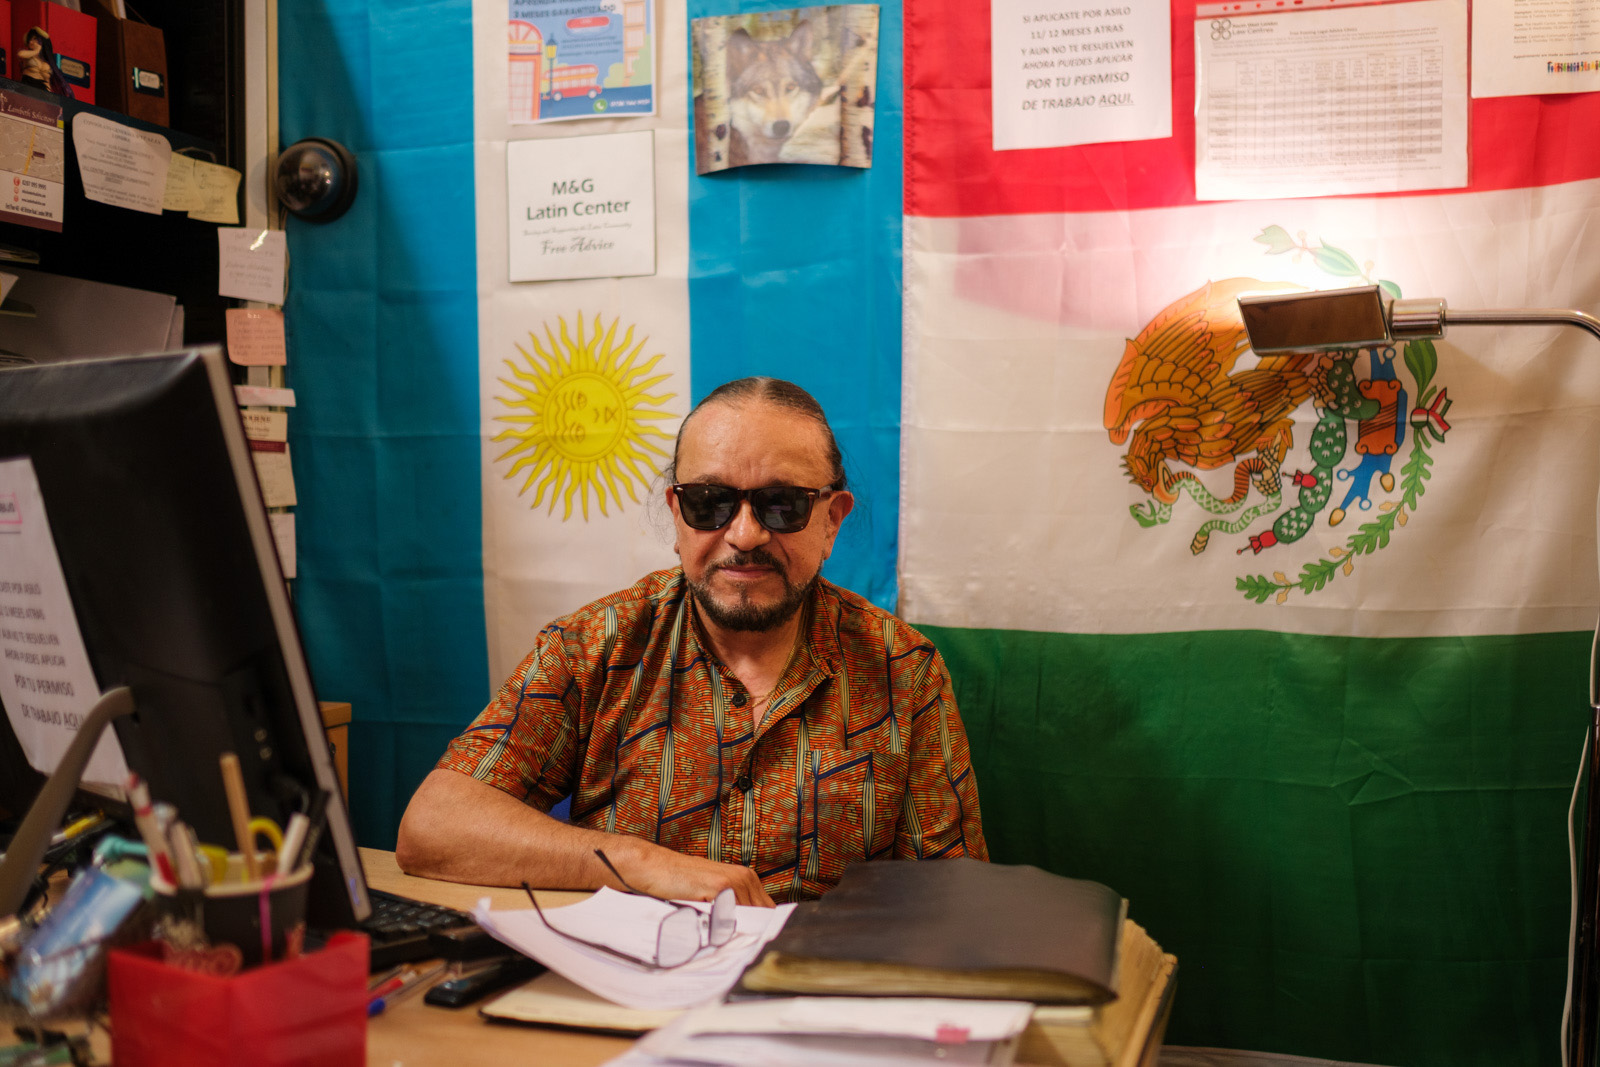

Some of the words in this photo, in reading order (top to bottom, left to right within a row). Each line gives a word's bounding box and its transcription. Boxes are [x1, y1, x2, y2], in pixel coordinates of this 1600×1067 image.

[1033, 12, 1080, 23] APLICASTE
[1082, 10, 1102, 19] POR
[1104, 6, 1132, 17] ASILO
[1062, 27, 1092, 37] MESES
[1094, 24, 1124, 34] ATRAS
[1029, 46, 1050, 56] AUN
[1052, 46, 1066, 54] NO
[1069, 44, 1079, 53] TE
[1081, 39, 1134, 52] RESUELVEN
[1023, 61, 1055, 70] AHORA
[1057, 57, 1093, 68] PUEDES
[1095, 53, 1133, 65] APLICAR
[1026, 78, 1052, 90] POR
[1055, 77, 1072, 88] TU
[1073, 72, 1130, 87] PERMISO
[1022, 100, 1038, 111] DE
[1042, 95, 1096, 109] TRABAJO
[552, 179, 594, 196] M&G
[526, 204, 568, 221] Latin
[573, 200, 631, 216] Center
[541, 239, 567, 255] Free
[570, 236, 615, 253] Advice
[36, 679, 74, 697] PERMISO
[30, 705, 61, 725] TRABAJO
